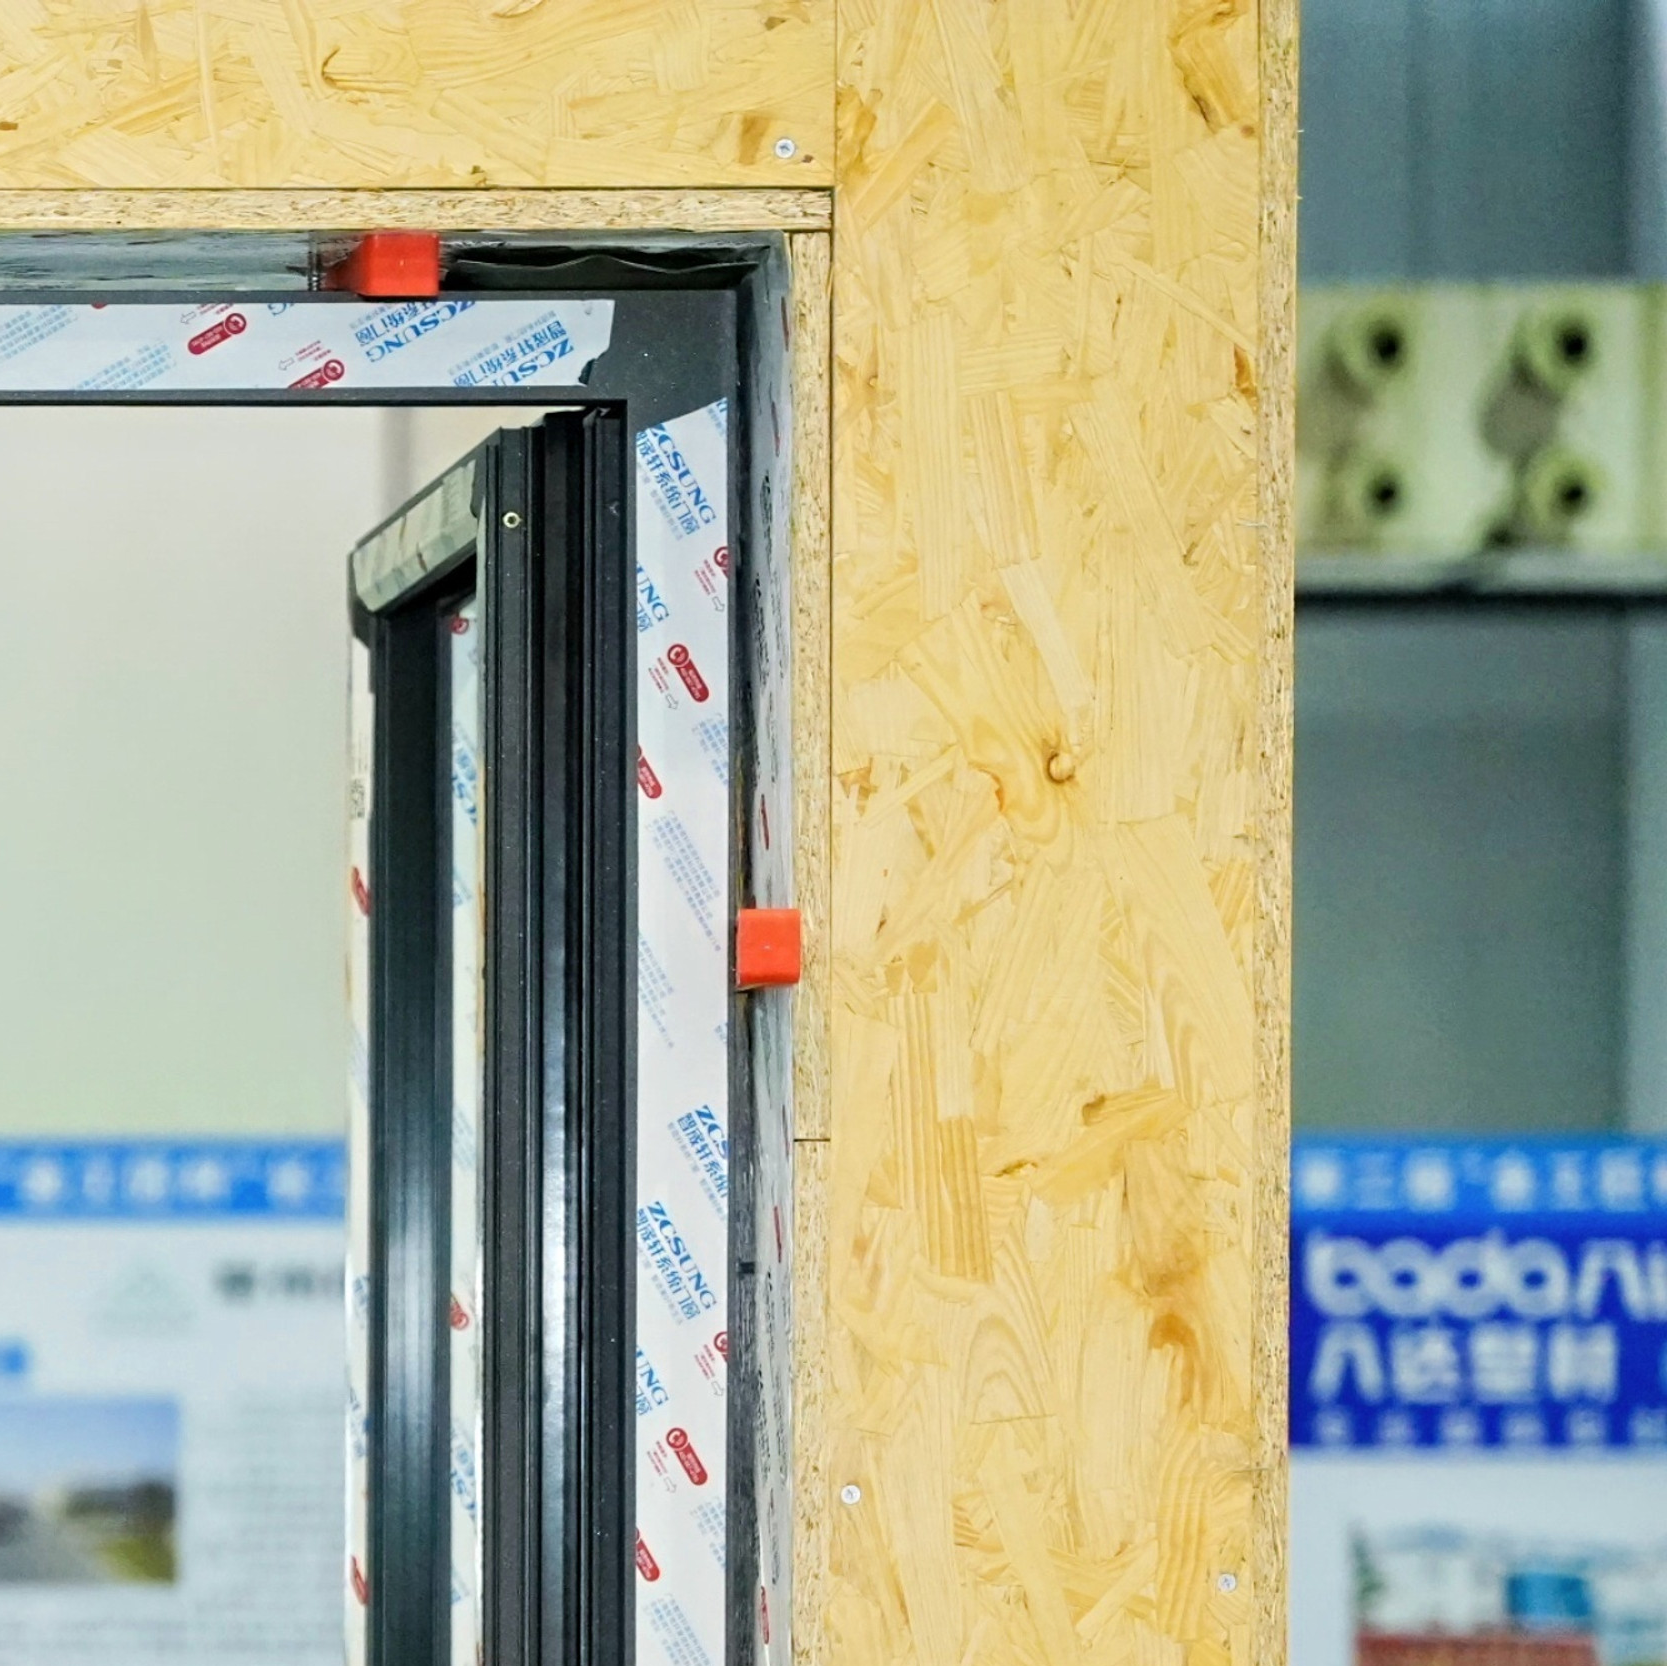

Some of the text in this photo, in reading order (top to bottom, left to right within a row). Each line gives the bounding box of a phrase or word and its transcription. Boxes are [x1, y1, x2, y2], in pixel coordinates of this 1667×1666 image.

[492, 337, 574, 386] ZCSU
[648, 424, 716, 525] ZCSUNG
[647, 1201, 716, 1309] ZCSUNG
